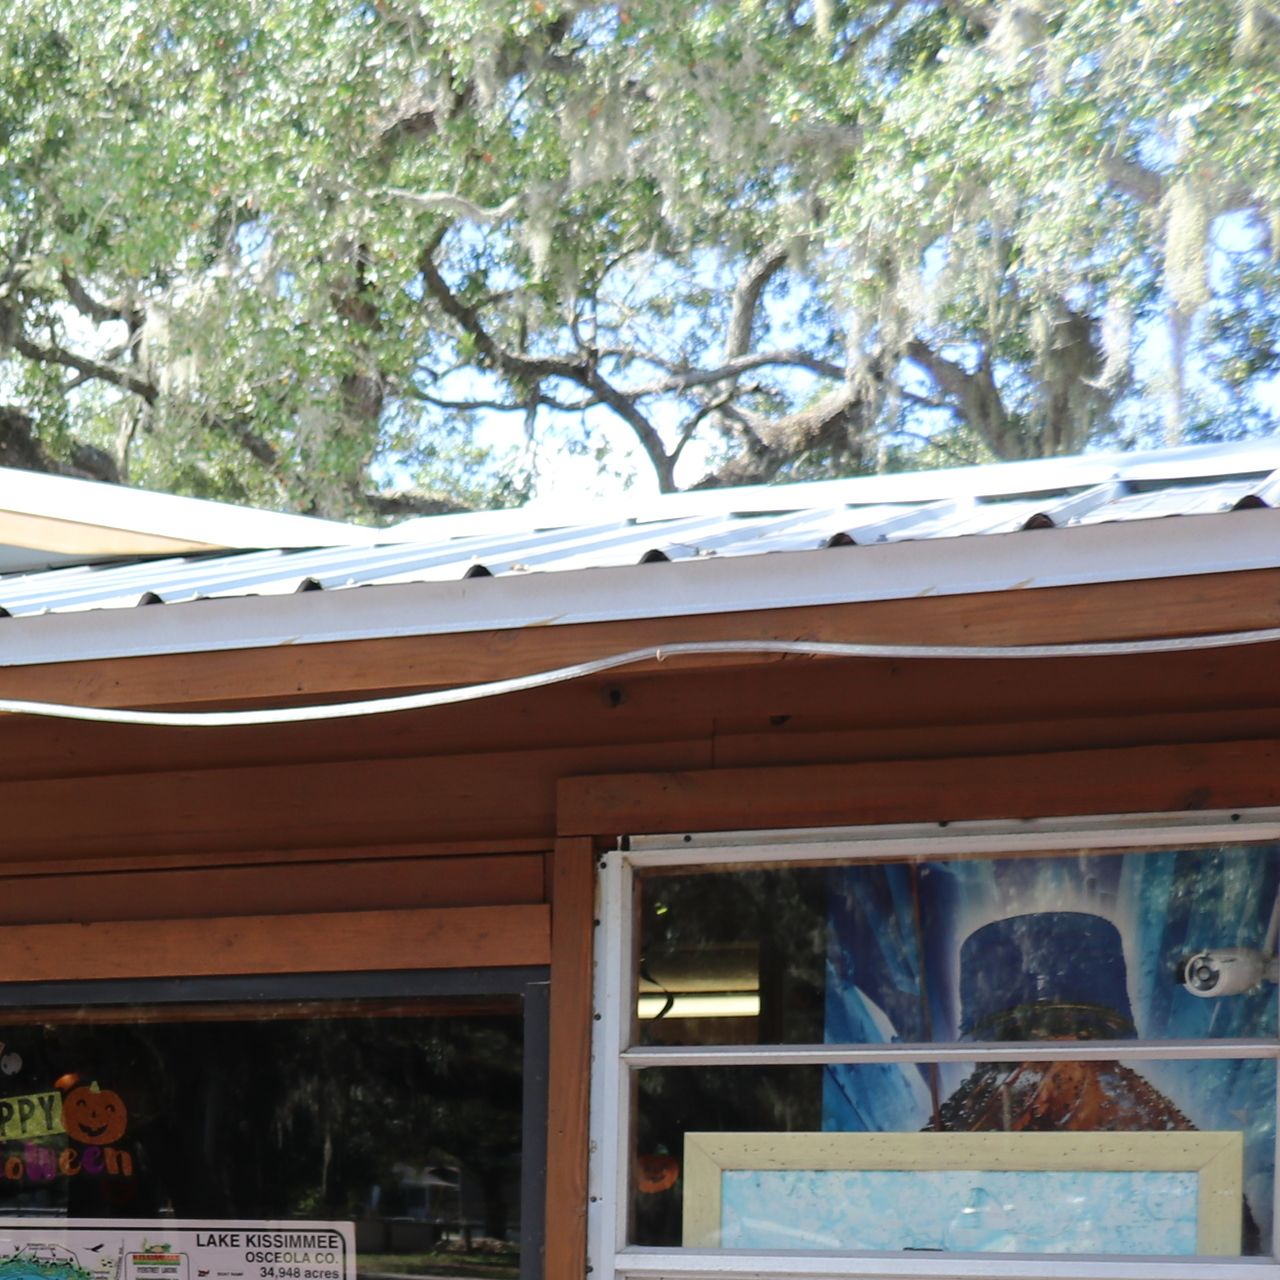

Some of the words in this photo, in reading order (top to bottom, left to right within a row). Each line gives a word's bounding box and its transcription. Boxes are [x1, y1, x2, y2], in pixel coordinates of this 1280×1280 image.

[196, 1233, 240, 1248] LAKE
[245, 1234, 339, 1249] KISSIMMEE
[245, 1251, 311, 1264] OSCEOLA
[314, 1252, 339, 1264] CO.
[259, 1266, 301, 1280] 34,948
[304, 1268, 340, 1279] acres
